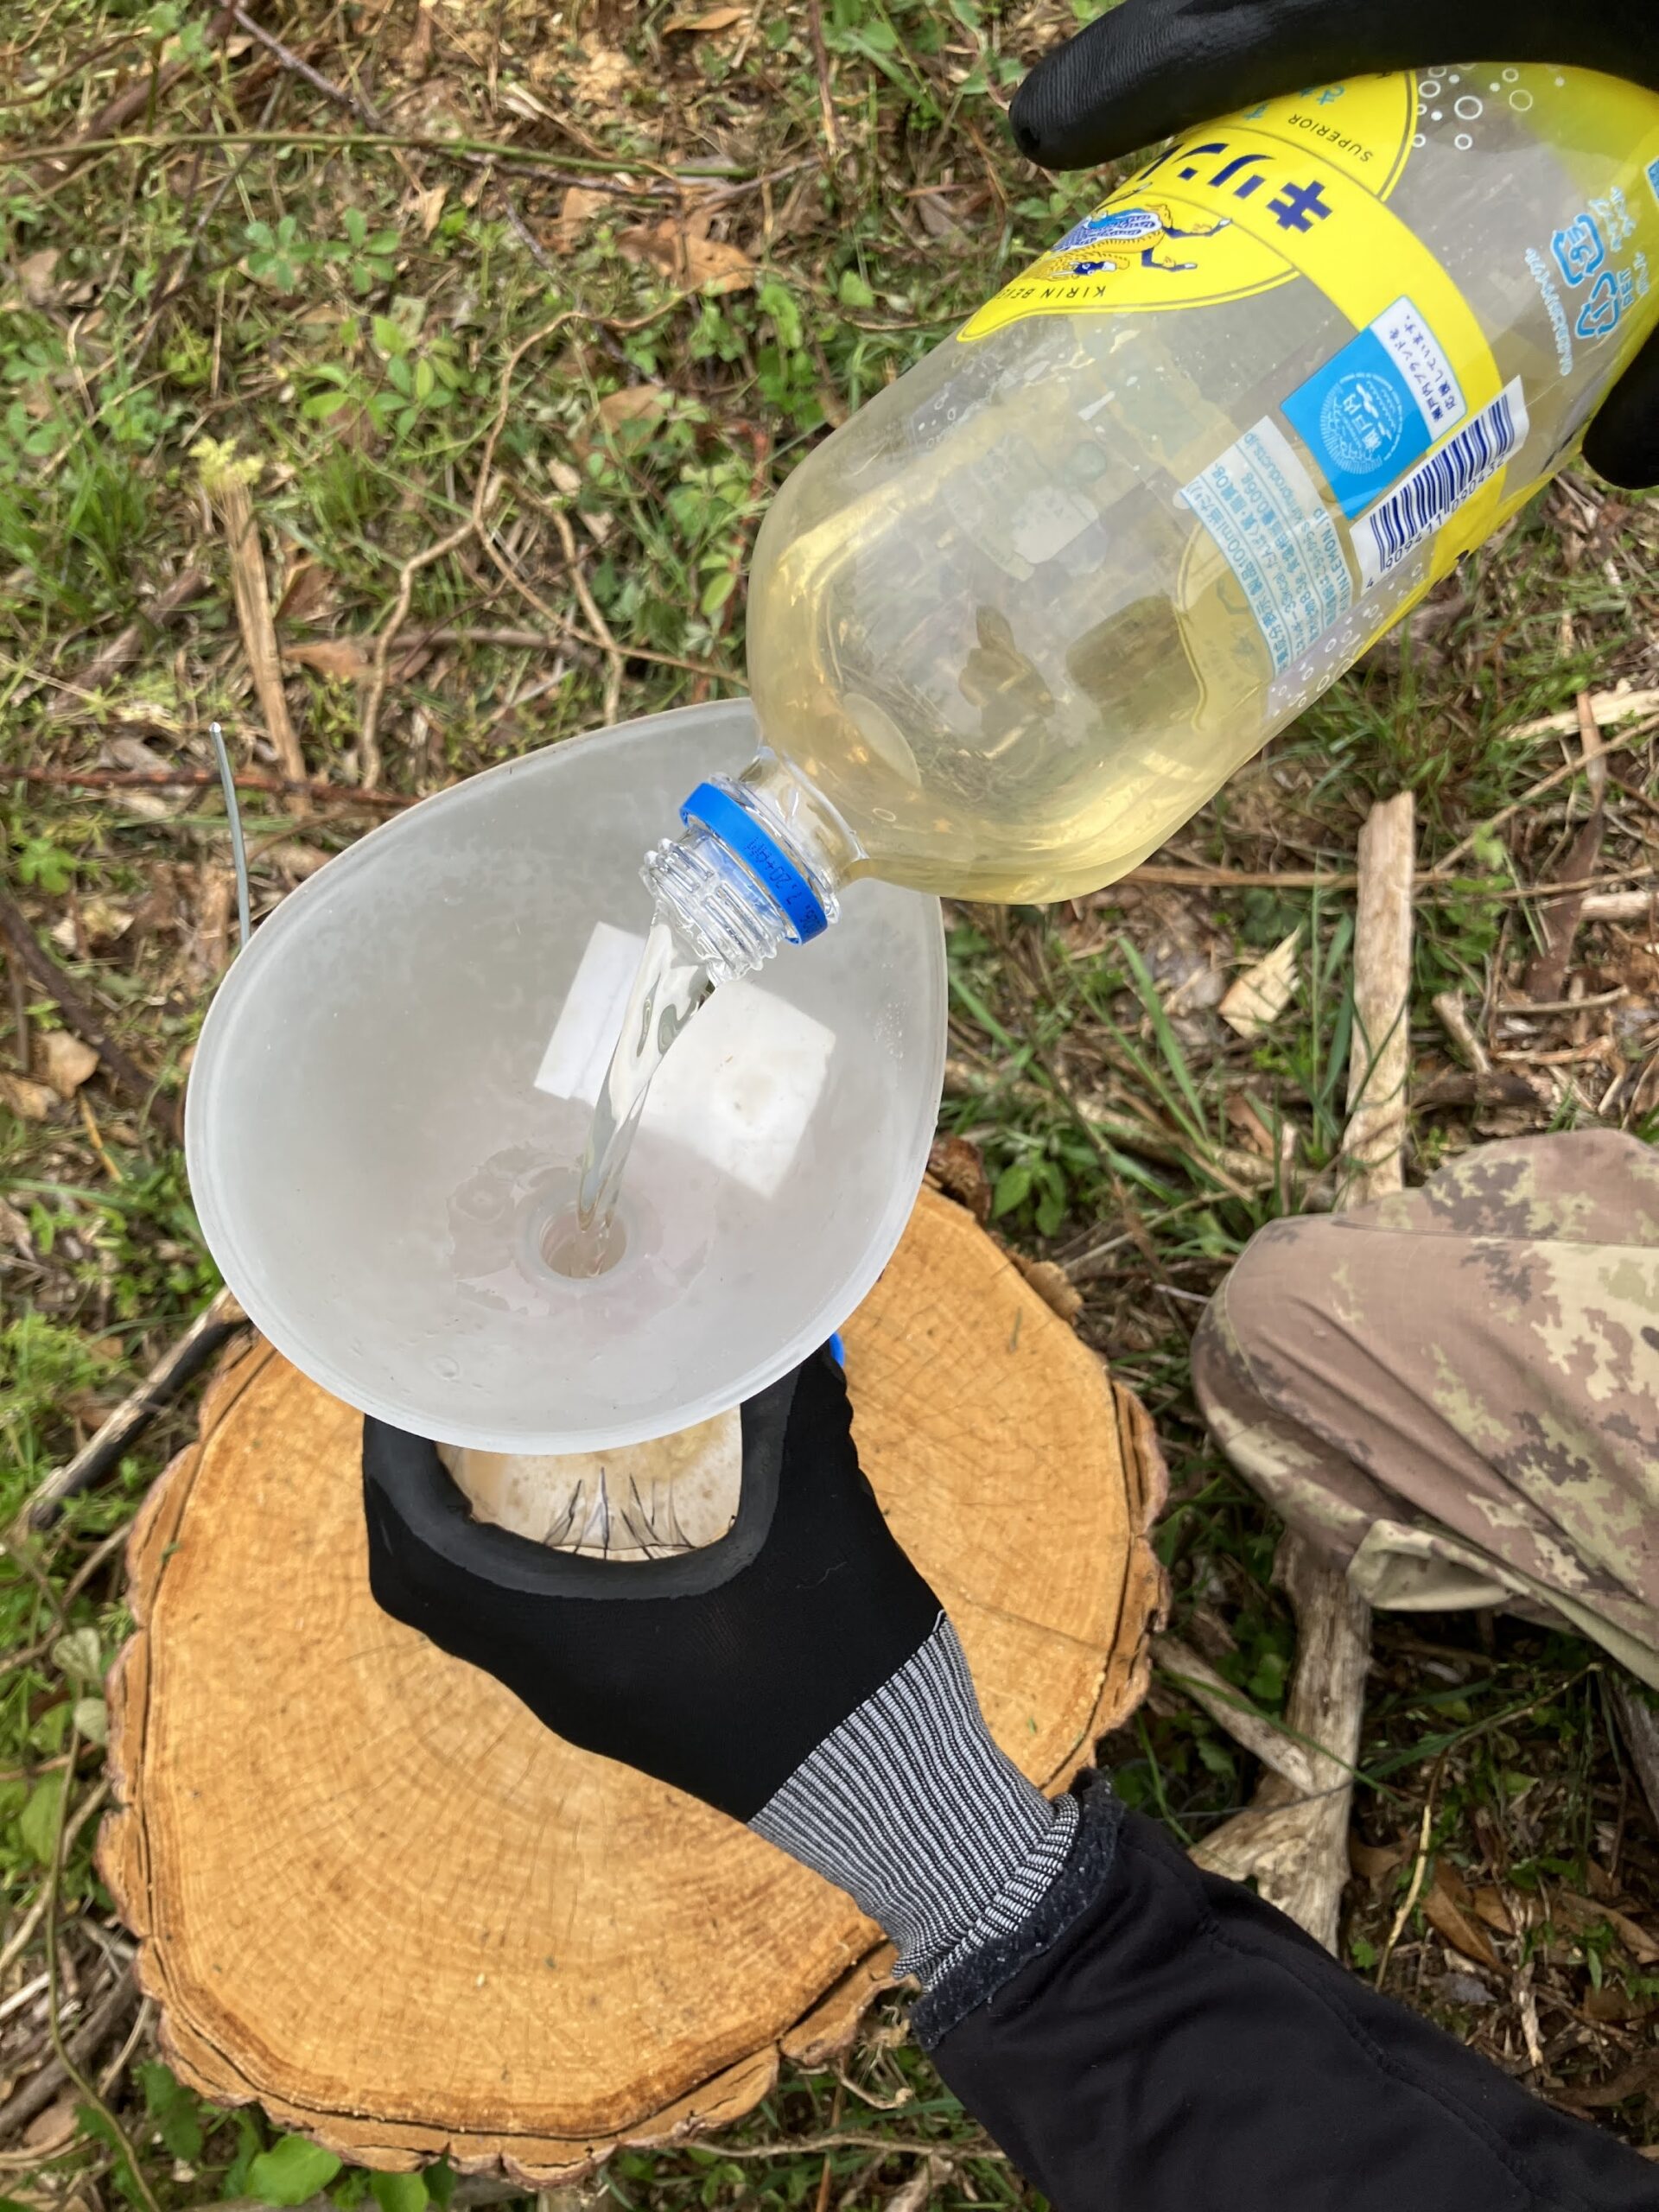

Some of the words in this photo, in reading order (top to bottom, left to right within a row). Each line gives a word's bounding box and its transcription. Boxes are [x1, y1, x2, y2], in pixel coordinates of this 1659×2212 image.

[1287, 112, 1373, 162] SUPERIOR
[1041, 285, 1105, 297] KIRIN
[1618, 268, 1634, 308] PET
[1389, 328, 1442, 422] 瀬戸内ブランドを
[1342, 393, 1381, 450] 瀬戸内
[1384, 512, 1444, 569] 909411
[1450, 452, 1505, 513] 090432
